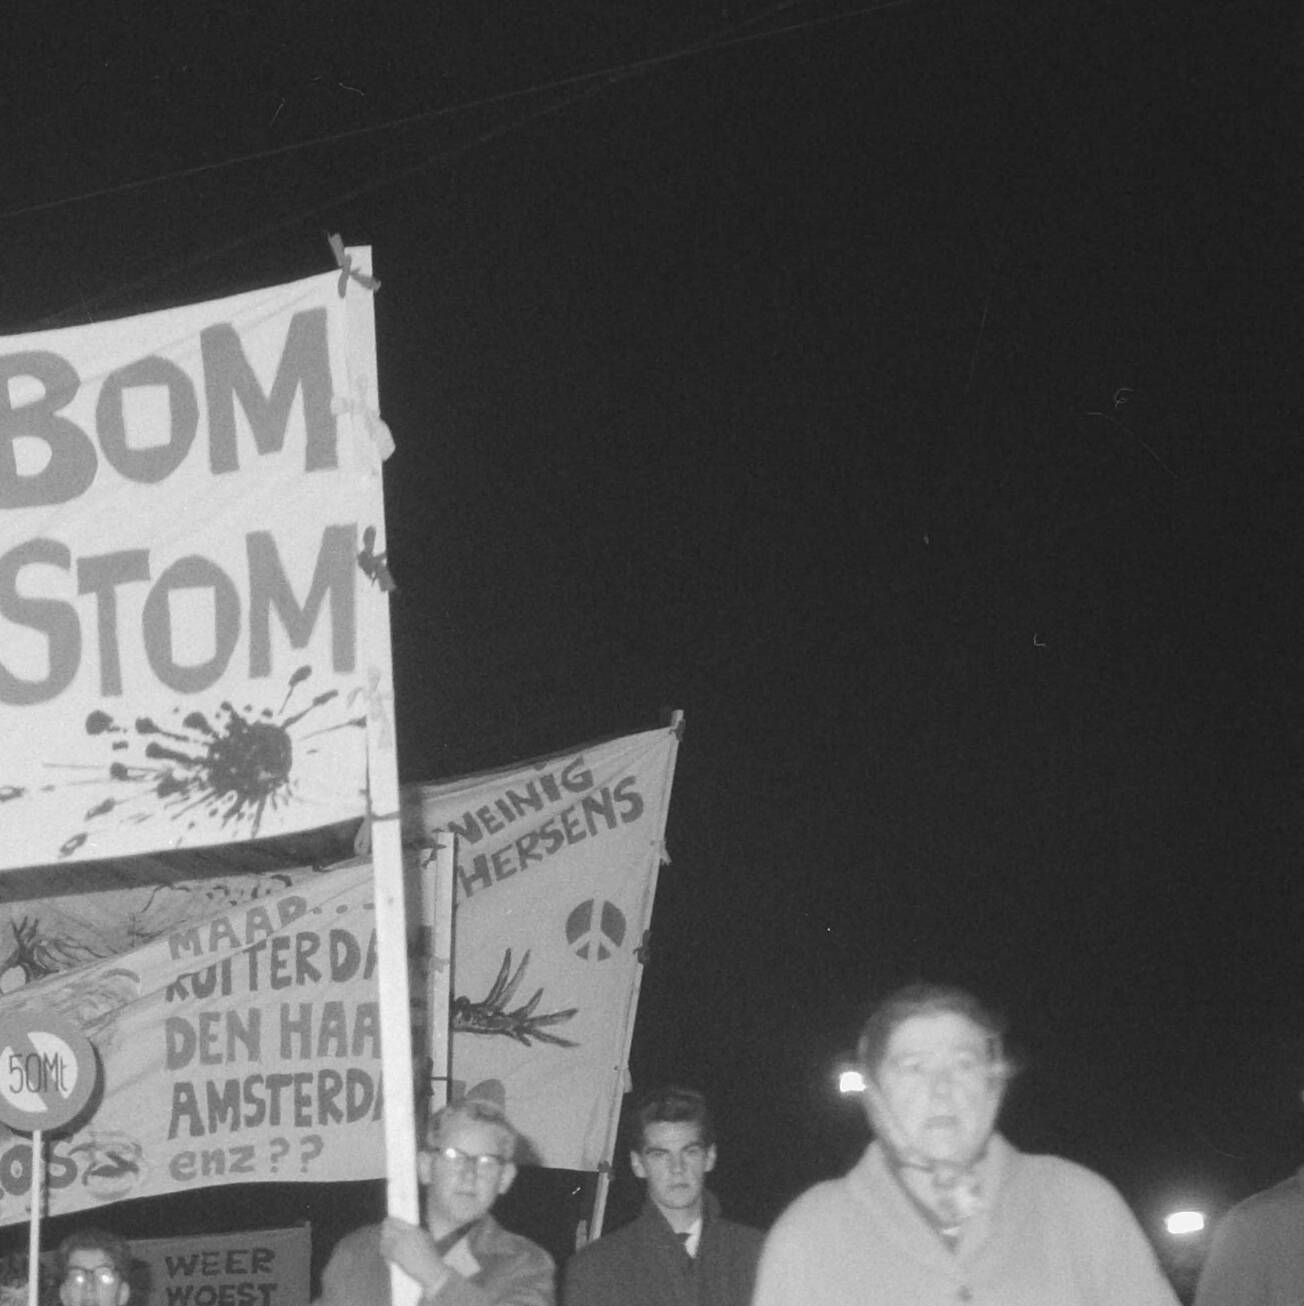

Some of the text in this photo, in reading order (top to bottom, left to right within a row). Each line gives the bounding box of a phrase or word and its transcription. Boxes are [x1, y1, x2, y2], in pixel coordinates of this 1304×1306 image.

[458, 775, 645, 898] HERSENS
[165, 1000, 381, 1071] DEN HAA
[8, 1051, 68, 1094] 50Mt
[167, 1067, 384, 1140] AMSTERD
[164, 1247, 277, 1279] WEER
